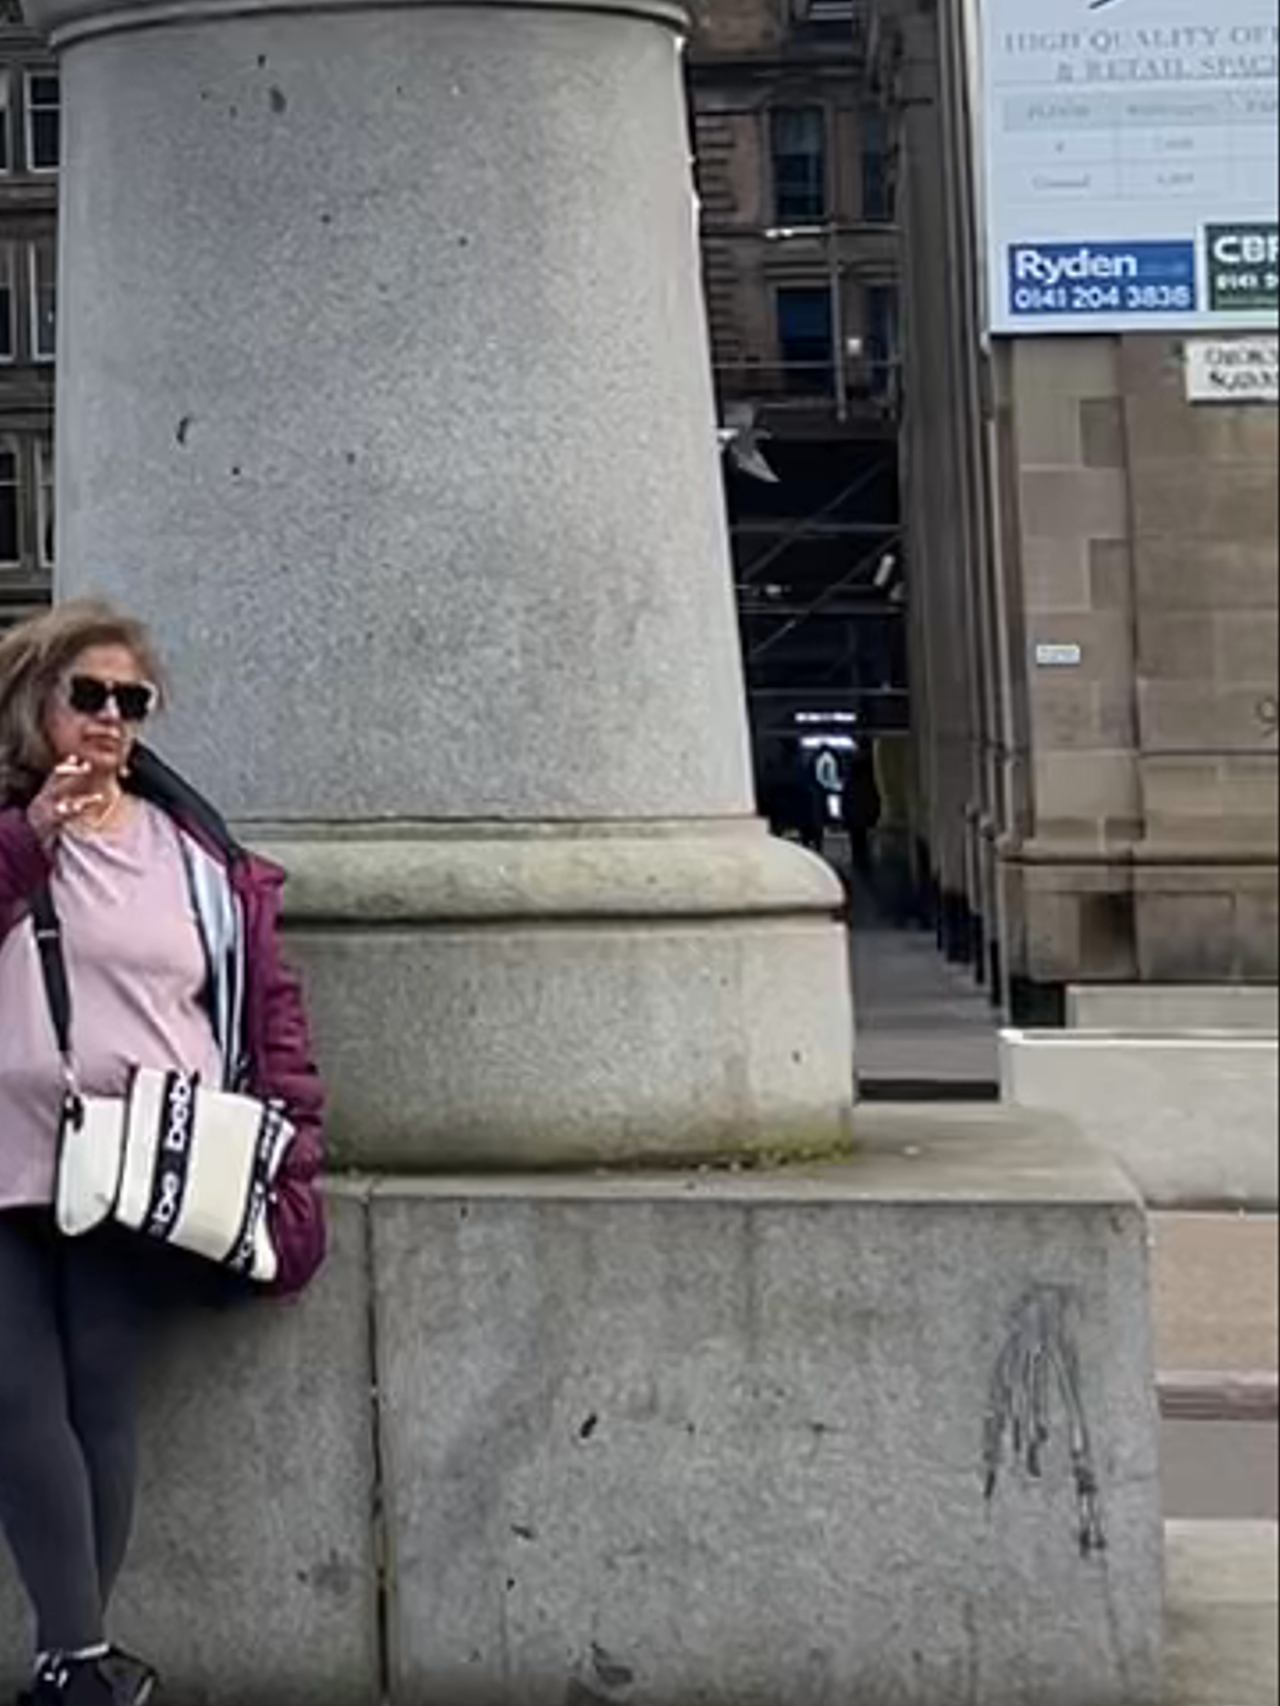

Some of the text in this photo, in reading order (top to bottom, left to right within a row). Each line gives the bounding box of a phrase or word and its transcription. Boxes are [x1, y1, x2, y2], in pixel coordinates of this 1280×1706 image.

[1004, 31, 1080, 53] HIGH
[1089, 26, 1219, 53] QUALITY
[1085, 57, 1185, 80] RETAIL
[1015, 248, 1138, 284] Ryden
[1015, 287, 1066, 308] 0141
[1072, 285, 1118, 308] 204
